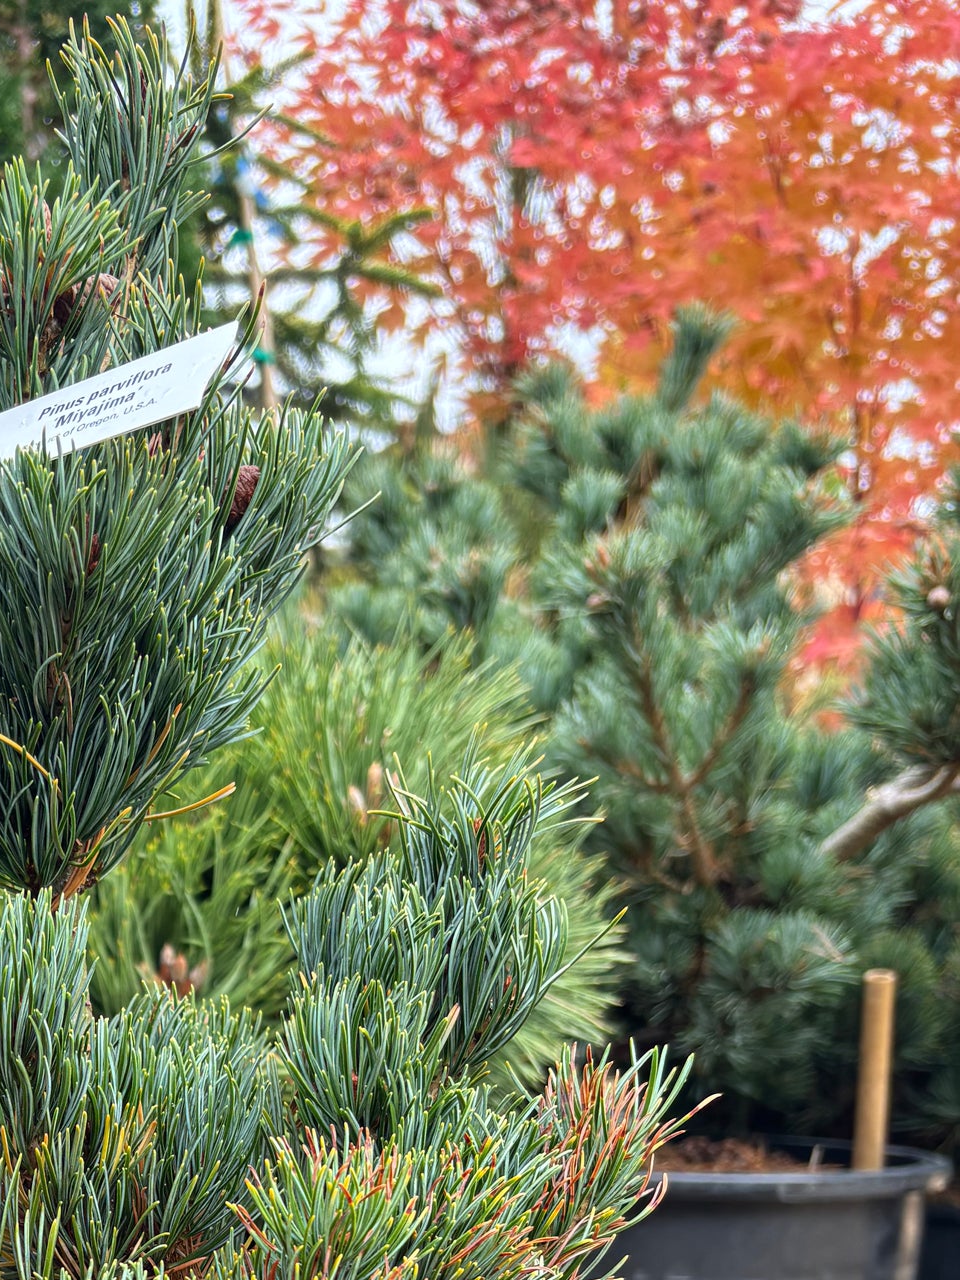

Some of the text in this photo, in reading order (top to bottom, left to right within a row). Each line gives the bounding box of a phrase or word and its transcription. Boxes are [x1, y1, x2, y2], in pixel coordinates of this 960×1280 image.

[38, 362, 173, 420] Pinus parviflora
[63, 397, 158, 438] of Oregon, U.S.A.
